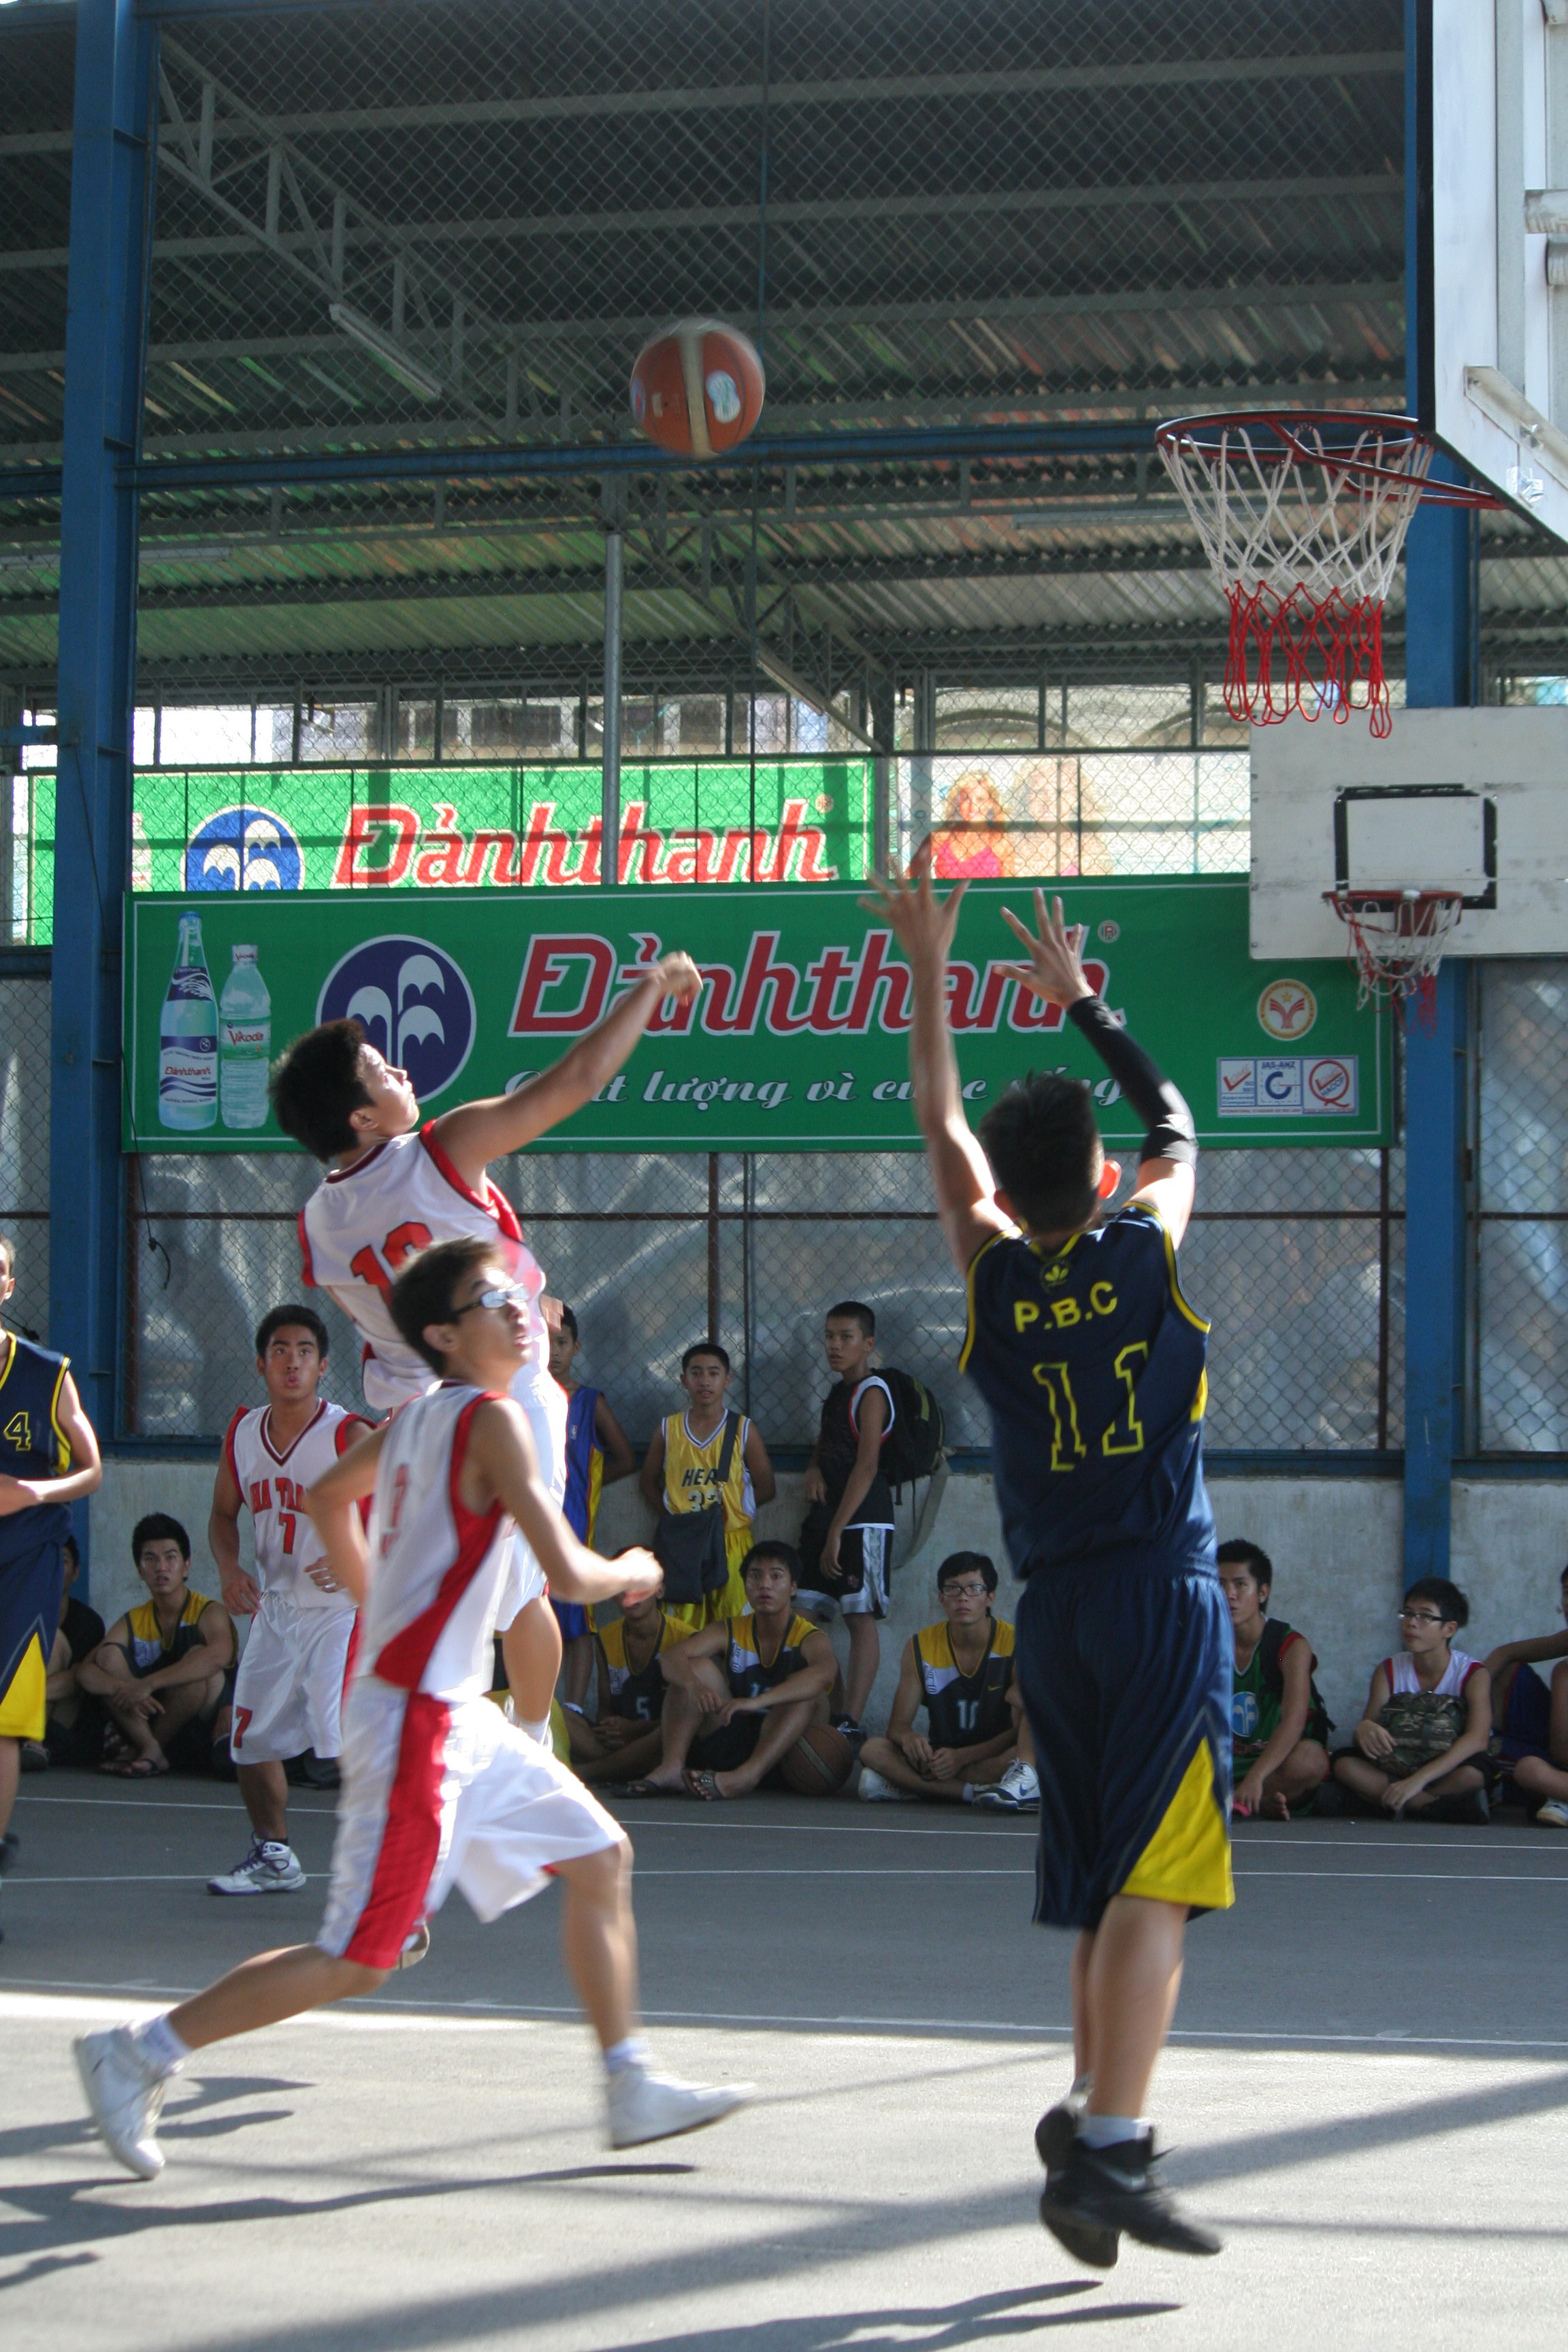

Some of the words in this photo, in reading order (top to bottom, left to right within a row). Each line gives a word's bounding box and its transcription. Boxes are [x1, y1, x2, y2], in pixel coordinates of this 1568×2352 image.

[1013, 1281, 1117, 1333] P.B.C
[1032, 1341, 1148, 1471] 11
[3, 1411, 31, 1452] 4
[682, 1468, 718, 1487] HEA
[279, 1512, 297, 1554] 7
[233, 1706, 253, 1749] 7
